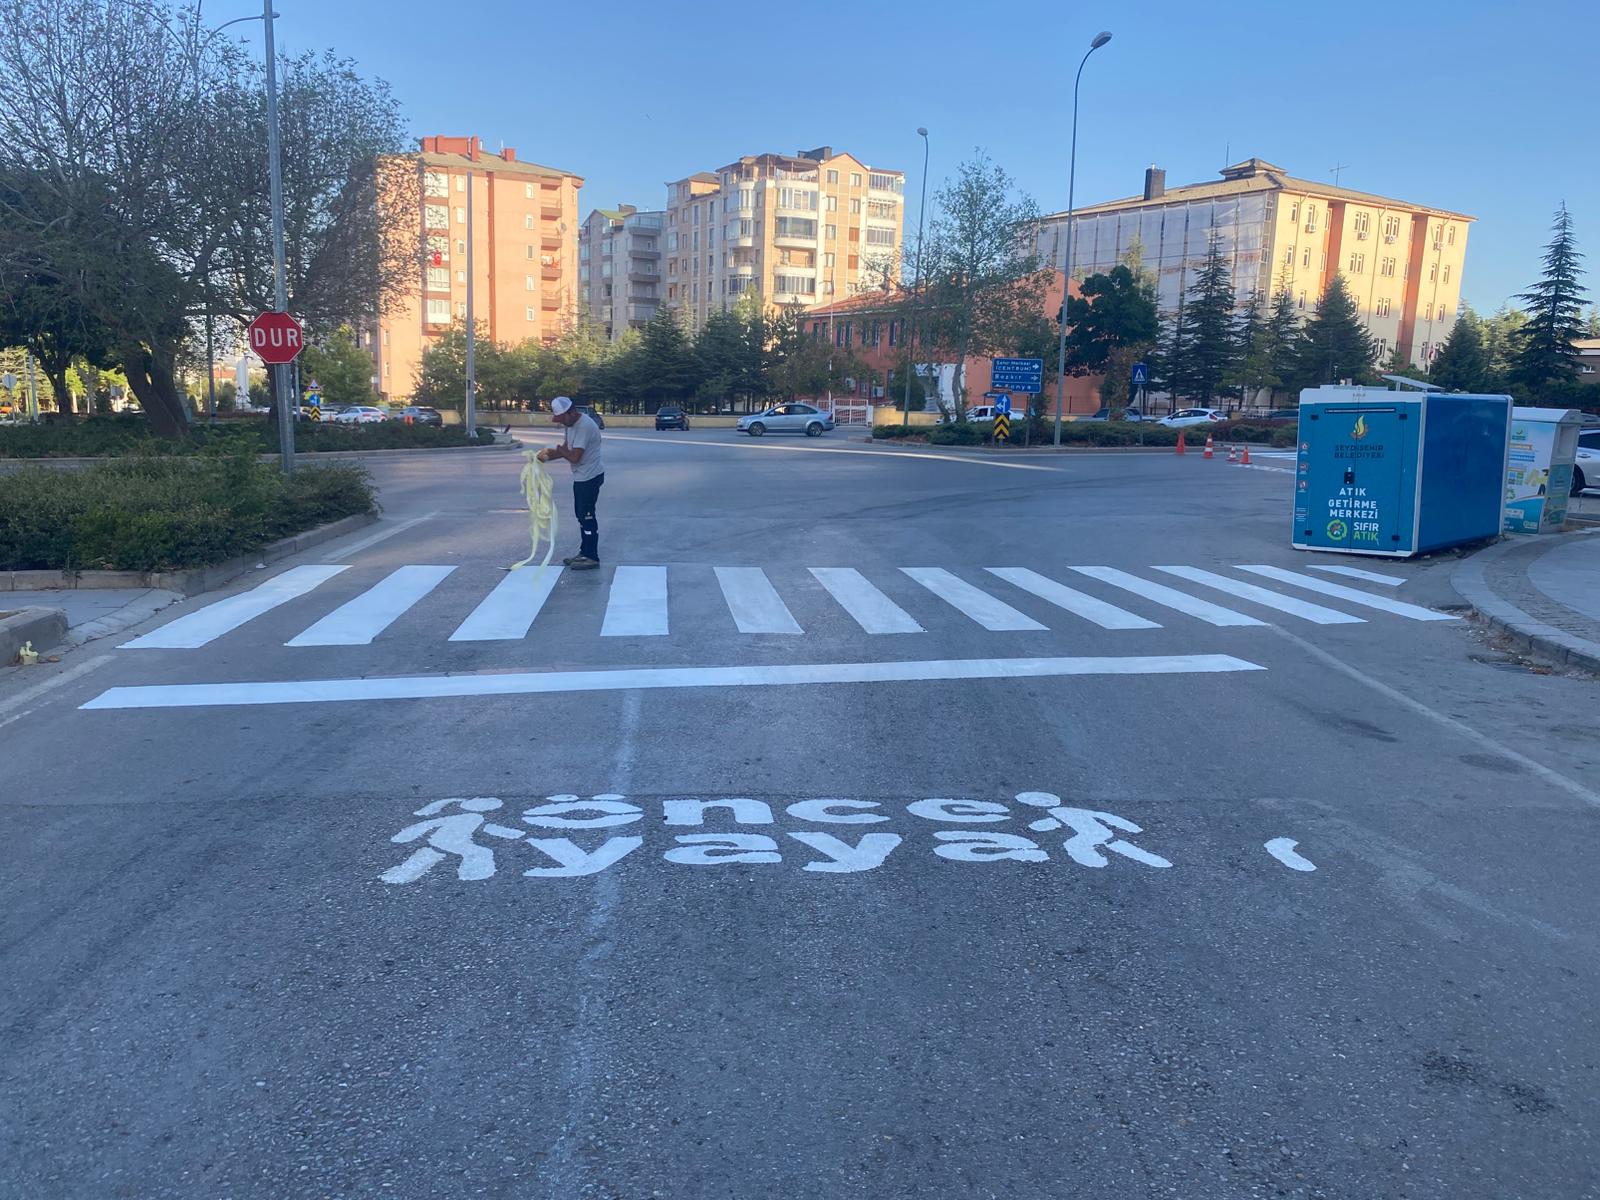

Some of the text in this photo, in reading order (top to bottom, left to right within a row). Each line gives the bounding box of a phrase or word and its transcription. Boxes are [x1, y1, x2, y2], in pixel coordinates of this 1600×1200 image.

[254, 327, 299, 347] DUR
[1339, 487, 1366, 496] ATIK
[1328, 497, 1377, 509] GETİRME
[1329, 508, 1378, 519] MERKEZİ
[1353, 521, 1379, 532] SIFIR
[1353, 531, 1378, 541] ATIK
[522, 794, 1011, 829] önce
[522, 831, 1050, 877] yaya
